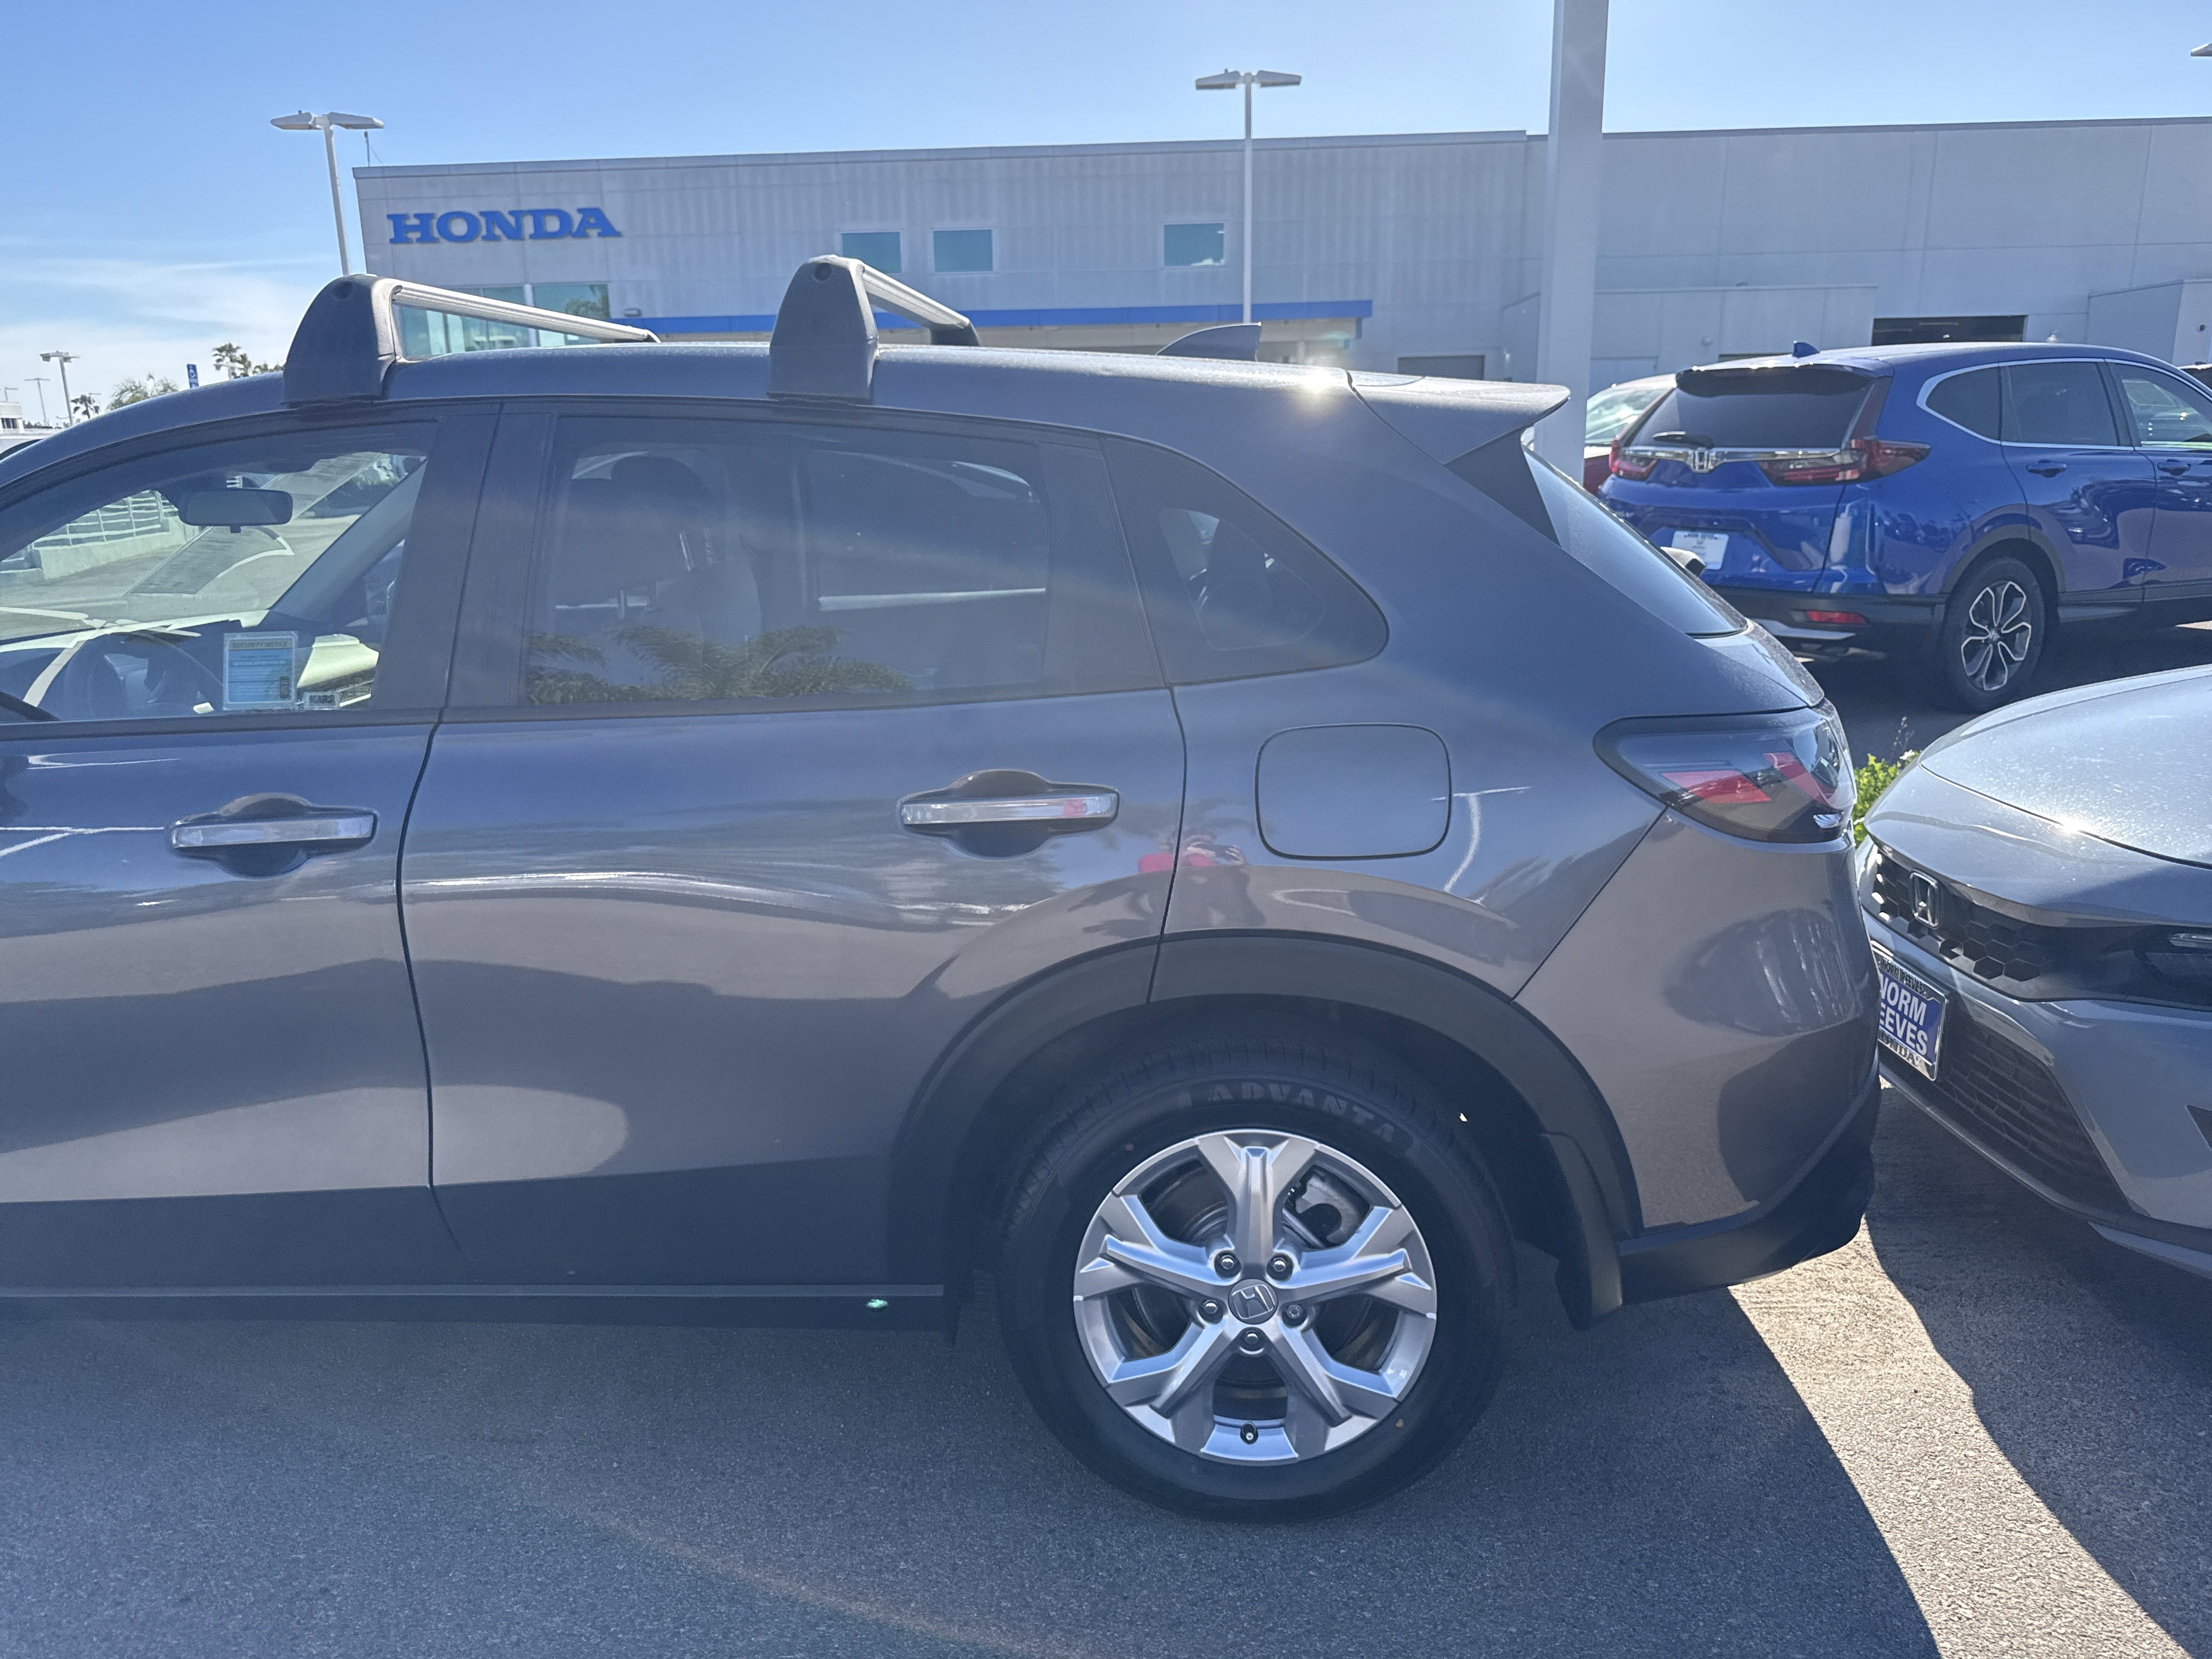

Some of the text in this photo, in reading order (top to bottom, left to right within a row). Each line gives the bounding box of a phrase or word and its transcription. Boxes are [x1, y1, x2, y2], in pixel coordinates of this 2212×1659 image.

[387, 207, 623, 244] HONDA
[1880, 972, 1927, 1026] NORM
[1879, 1002, 1928, 1056] EEVES
[1879, 1029, 1916, 1066] ONDA
[1207, 1081, 1394, 1144] ADVANTA
